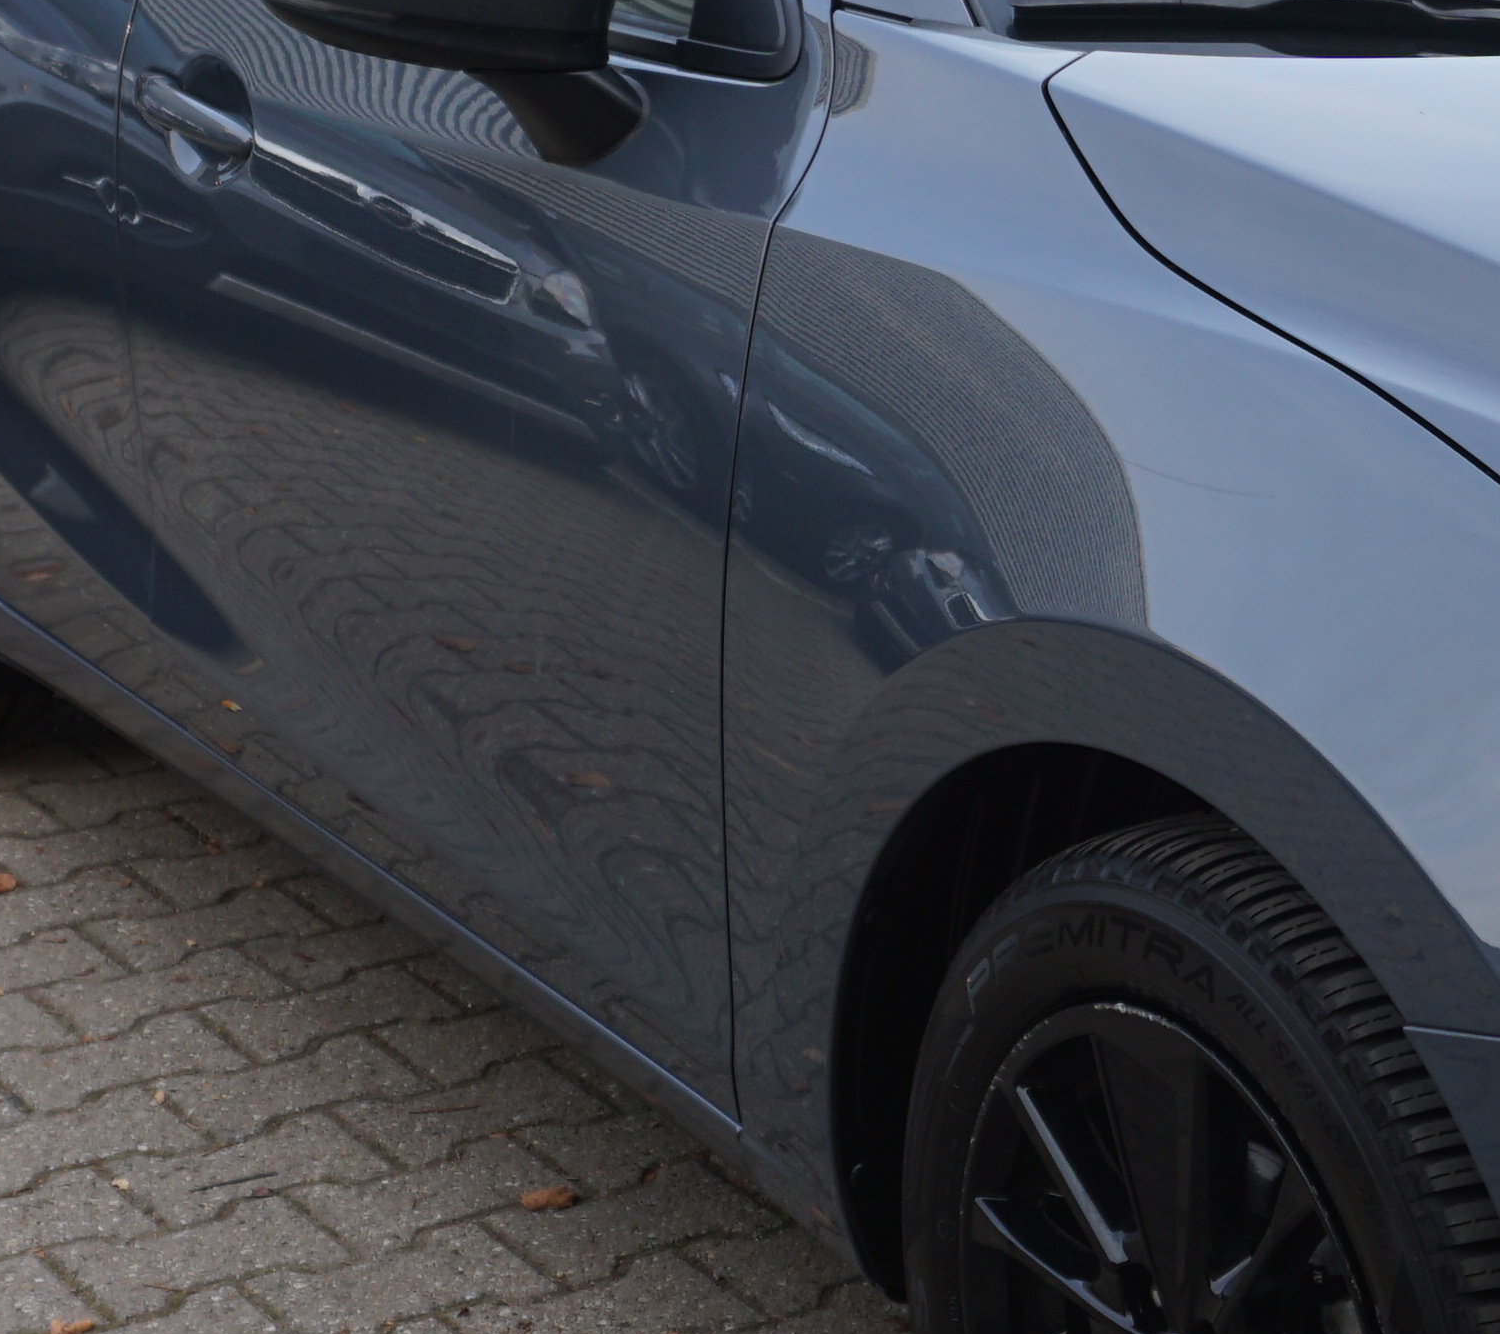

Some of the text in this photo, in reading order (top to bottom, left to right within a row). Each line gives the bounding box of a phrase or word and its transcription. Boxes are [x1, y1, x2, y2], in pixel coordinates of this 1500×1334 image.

[965, 912, 1352, 1159] PREMITRA ALL SEASO
